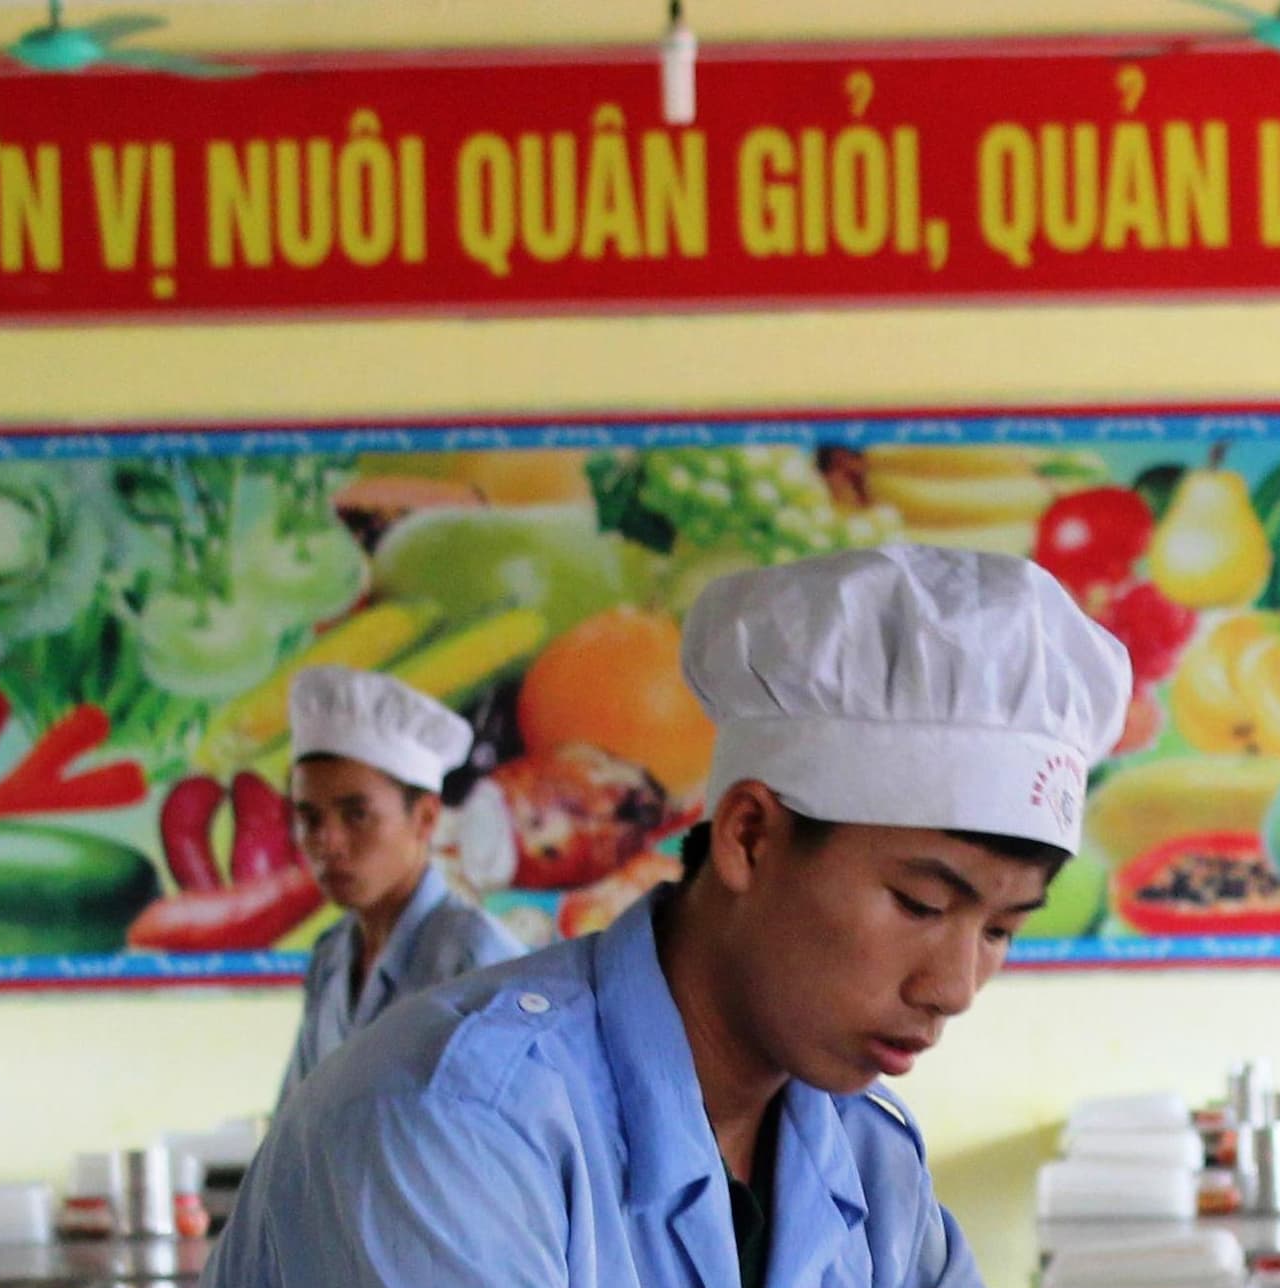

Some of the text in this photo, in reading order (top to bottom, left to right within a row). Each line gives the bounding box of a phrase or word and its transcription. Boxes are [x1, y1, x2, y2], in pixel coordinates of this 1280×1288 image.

[89, 140, 177, 299] VỊ
[206, 107, 426, 269] NUÔI
[456, 102, 710, 278] QUÂN
[737, 70, 950, 272] GIỎI,
[977, 64, 1231, 268] QUẢN
